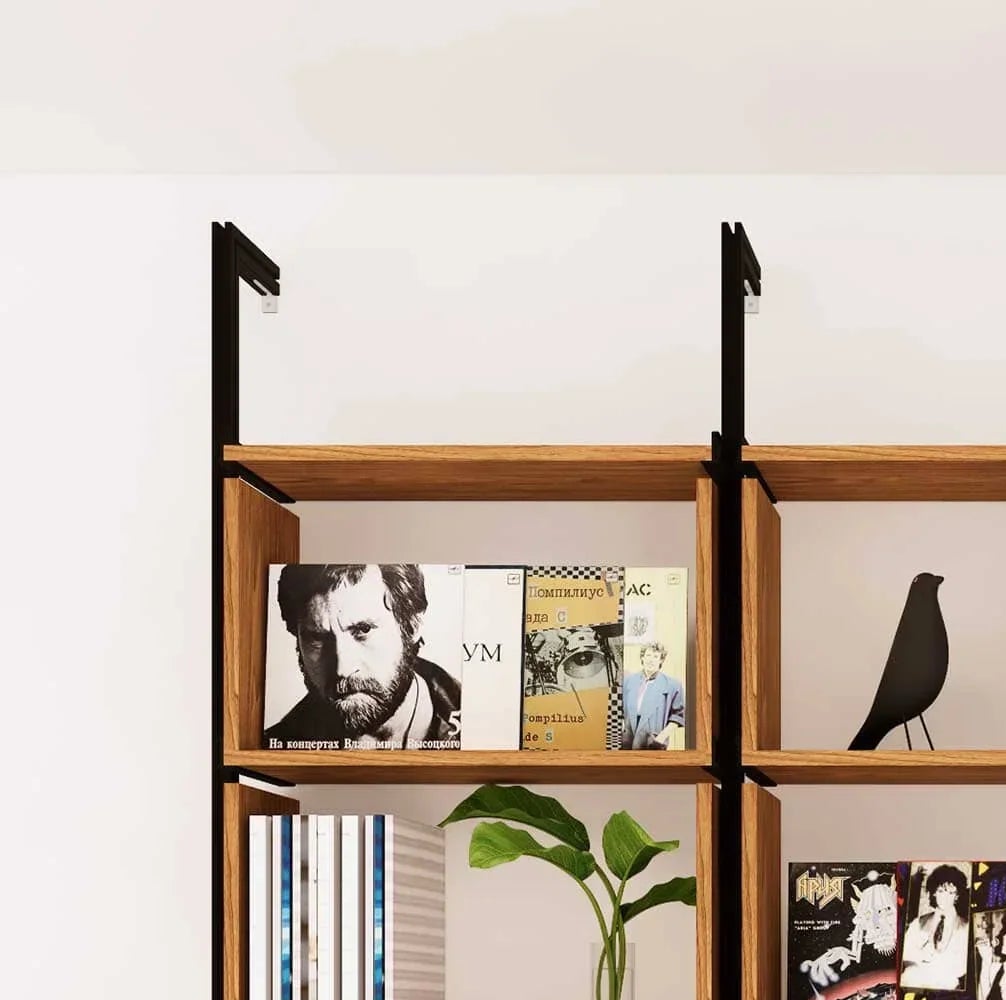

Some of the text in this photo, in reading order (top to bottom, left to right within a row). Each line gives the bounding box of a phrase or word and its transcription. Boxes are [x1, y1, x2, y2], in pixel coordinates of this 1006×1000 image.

[528, 586, 604, 600] Помпилиус
[462, 643, 503, 662] УМ
[447, 710, 461, 736] 5
[269, 738, 461, 750] На концертах Владимира Высоцкого
